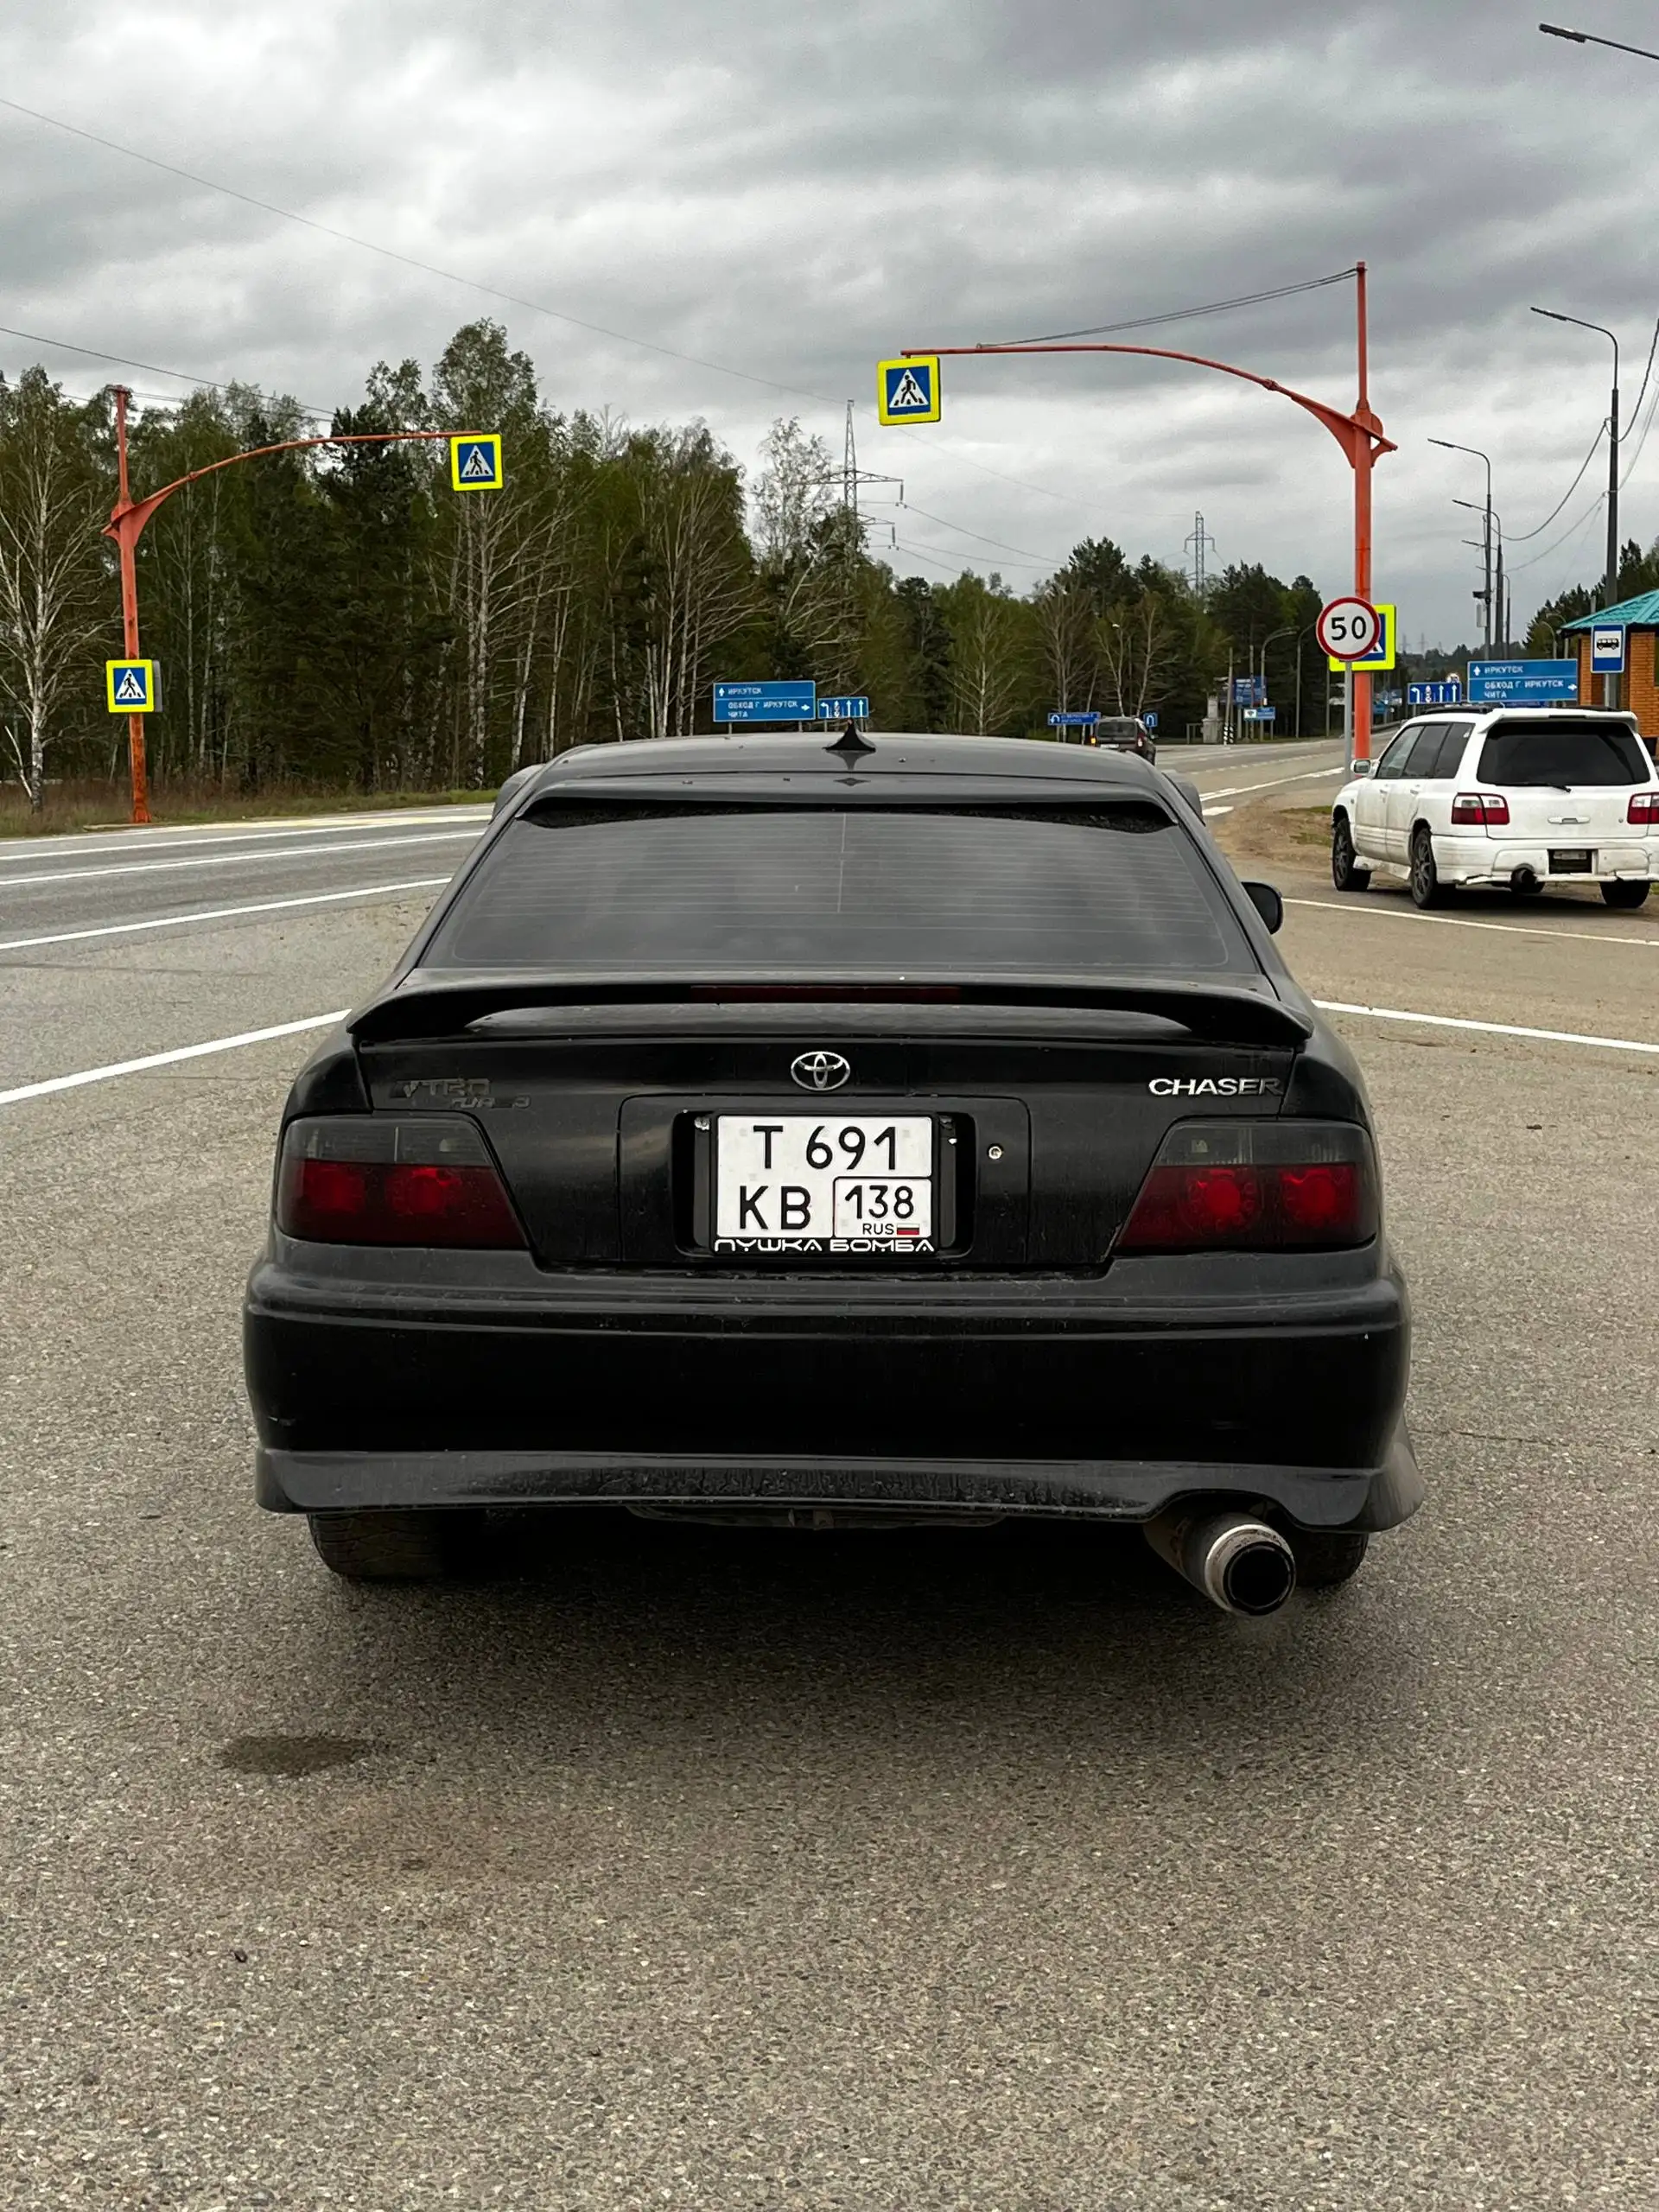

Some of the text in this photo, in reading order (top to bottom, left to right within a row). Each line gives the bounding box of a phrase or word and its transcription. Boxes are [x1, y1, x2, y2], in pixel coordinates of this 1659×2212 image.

[1331, 615, 1367, 641] 50
[1484, 665, 1523, 674] ИРКУТСК
[1484, 681, 1513, 690] ОБХОД
[1524, 679, 1564, 688] ИРКУТСК
[1484, 690, 1507, 699] ЧИТА
[728, 701, 753, 709] ОБХОД
[763, 700, 798, 709] ИРКУТСК
[1148, 1077, 1284, 1096] CHASER
[806, 1125, 896, 1170] 691
[740, 1185, 811, 1230] КВ
[845, 1185, 914, 1219] 138
[862, 1223, 894, 1236] RUS
[714, 1238, 935, 1252] ПУШКА БОМБА
